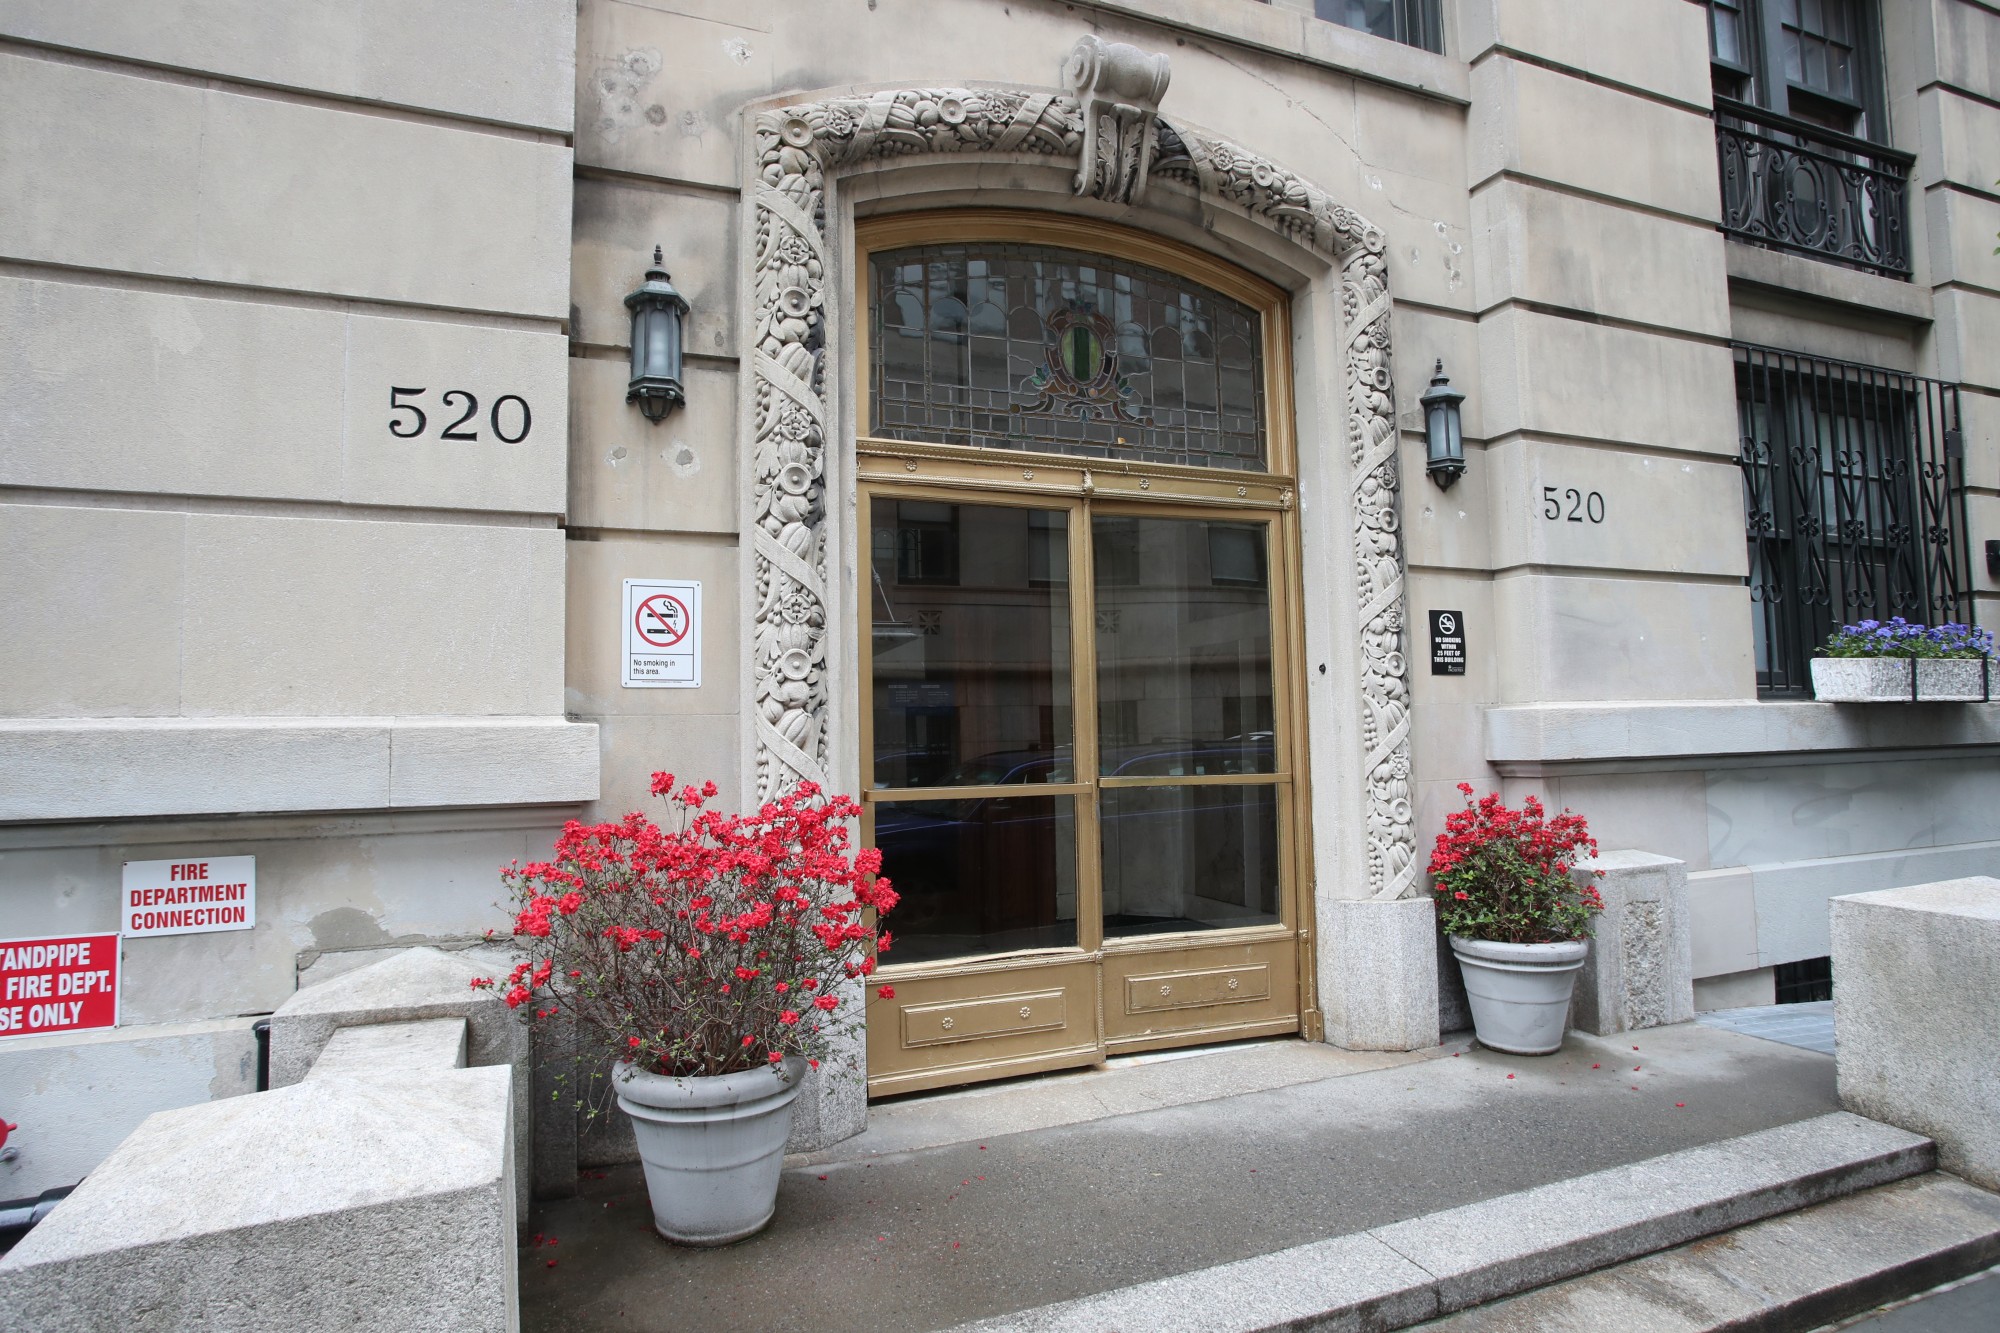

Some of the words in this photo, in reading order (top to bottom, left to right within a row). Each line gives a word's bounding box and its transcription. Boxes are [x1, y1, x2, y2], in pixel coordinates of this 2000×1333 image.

[389, 385, 532, 444] 520
[1543, 486, 1605, 524] 520
[633, 659, 642, 667] No
[643, 659, 669, 668] smoking
[669, 659, 676, 667] in
[171, 863, 208, 881] FIRE
[130, 883, 247, 907] DEPARTMENT
[131, 906, 245, 930] CONNECTION
[6, 973, 53, 1000] FIRE
[58, 970, 112, 996] DEPT.
[28, 1001, 84, 1028] ONLY
